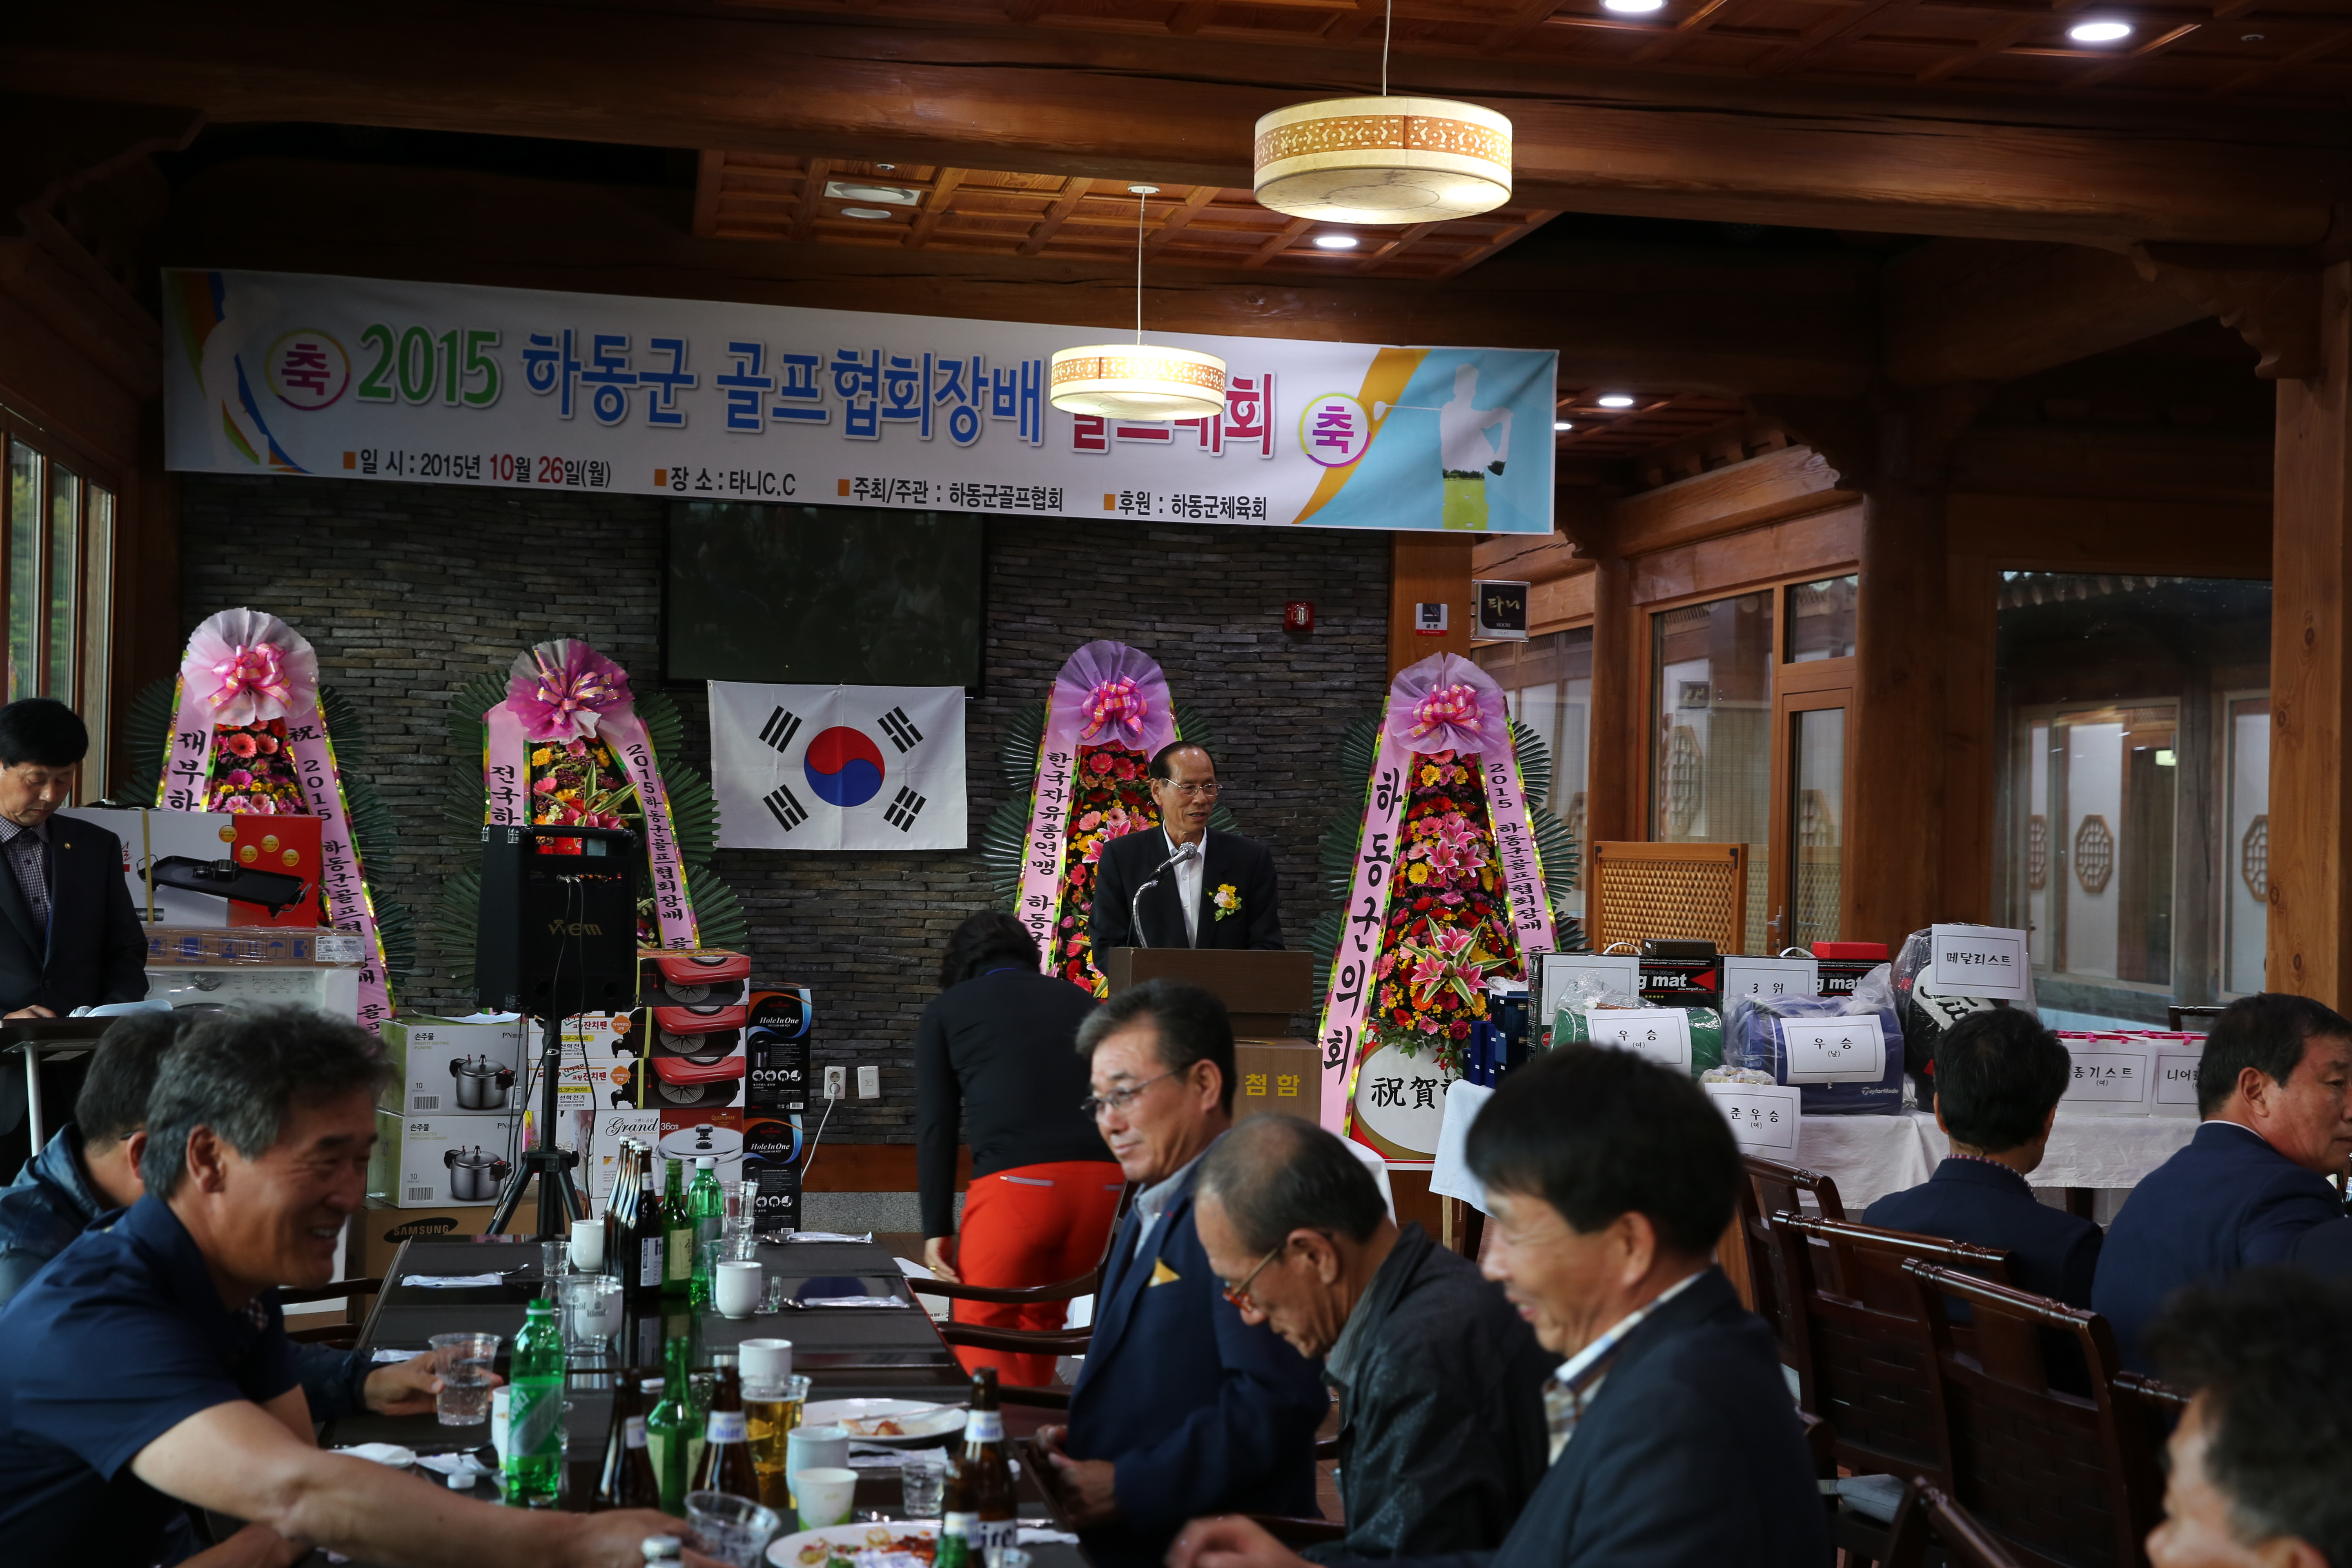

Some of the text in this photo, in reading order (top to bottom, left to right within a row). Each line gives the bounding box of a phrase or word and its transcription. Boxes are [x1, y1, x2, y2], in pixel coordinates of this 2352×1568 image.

[281, 342, 331, 394] 축
[358, 324, 498, 405] 2015
[523, 330, 694, 424] 하동군
[717, 342, 1041, 443] 골프협회장배
[1312, 406, 1354, 454] 축
[490, 454, 531, 483] 10월
[538, 457, 611, 488] 26일(월)
[853, 476, 929, 503] 주최/주관
[949, 482, 1062, 512] 하동군골프협회
[1118, 491, 1151, 516] 후원
[1172, 494, 1267, 520] 하동군체육회
[1487, 596, 1520, 617] 타니
[287, 725, 321, 743] 祝
[1489, 763, 1513, 808] 2015
[1031, 752, 1073, 876] 한국자유총연맹
[1496, 822, 1542, 931] 하동군골프협회장배
[1947, 952, 2011, 967] 메달리스트
[1652, 973, 1687, 987] mat
[1753, 982, 1784, 994] 3 위
[584, 1021, 607, 1030] 잔치팬
[583, 1072, 606, 1081] 잔치팬
[1861, 1086, 1899, 1095] TaylorMade
[605, 1117, 659, 1136] Grand
[660, 1123, 679, 1131] 36cm
[393, 1225, 449, 1236] SAMSUNG
